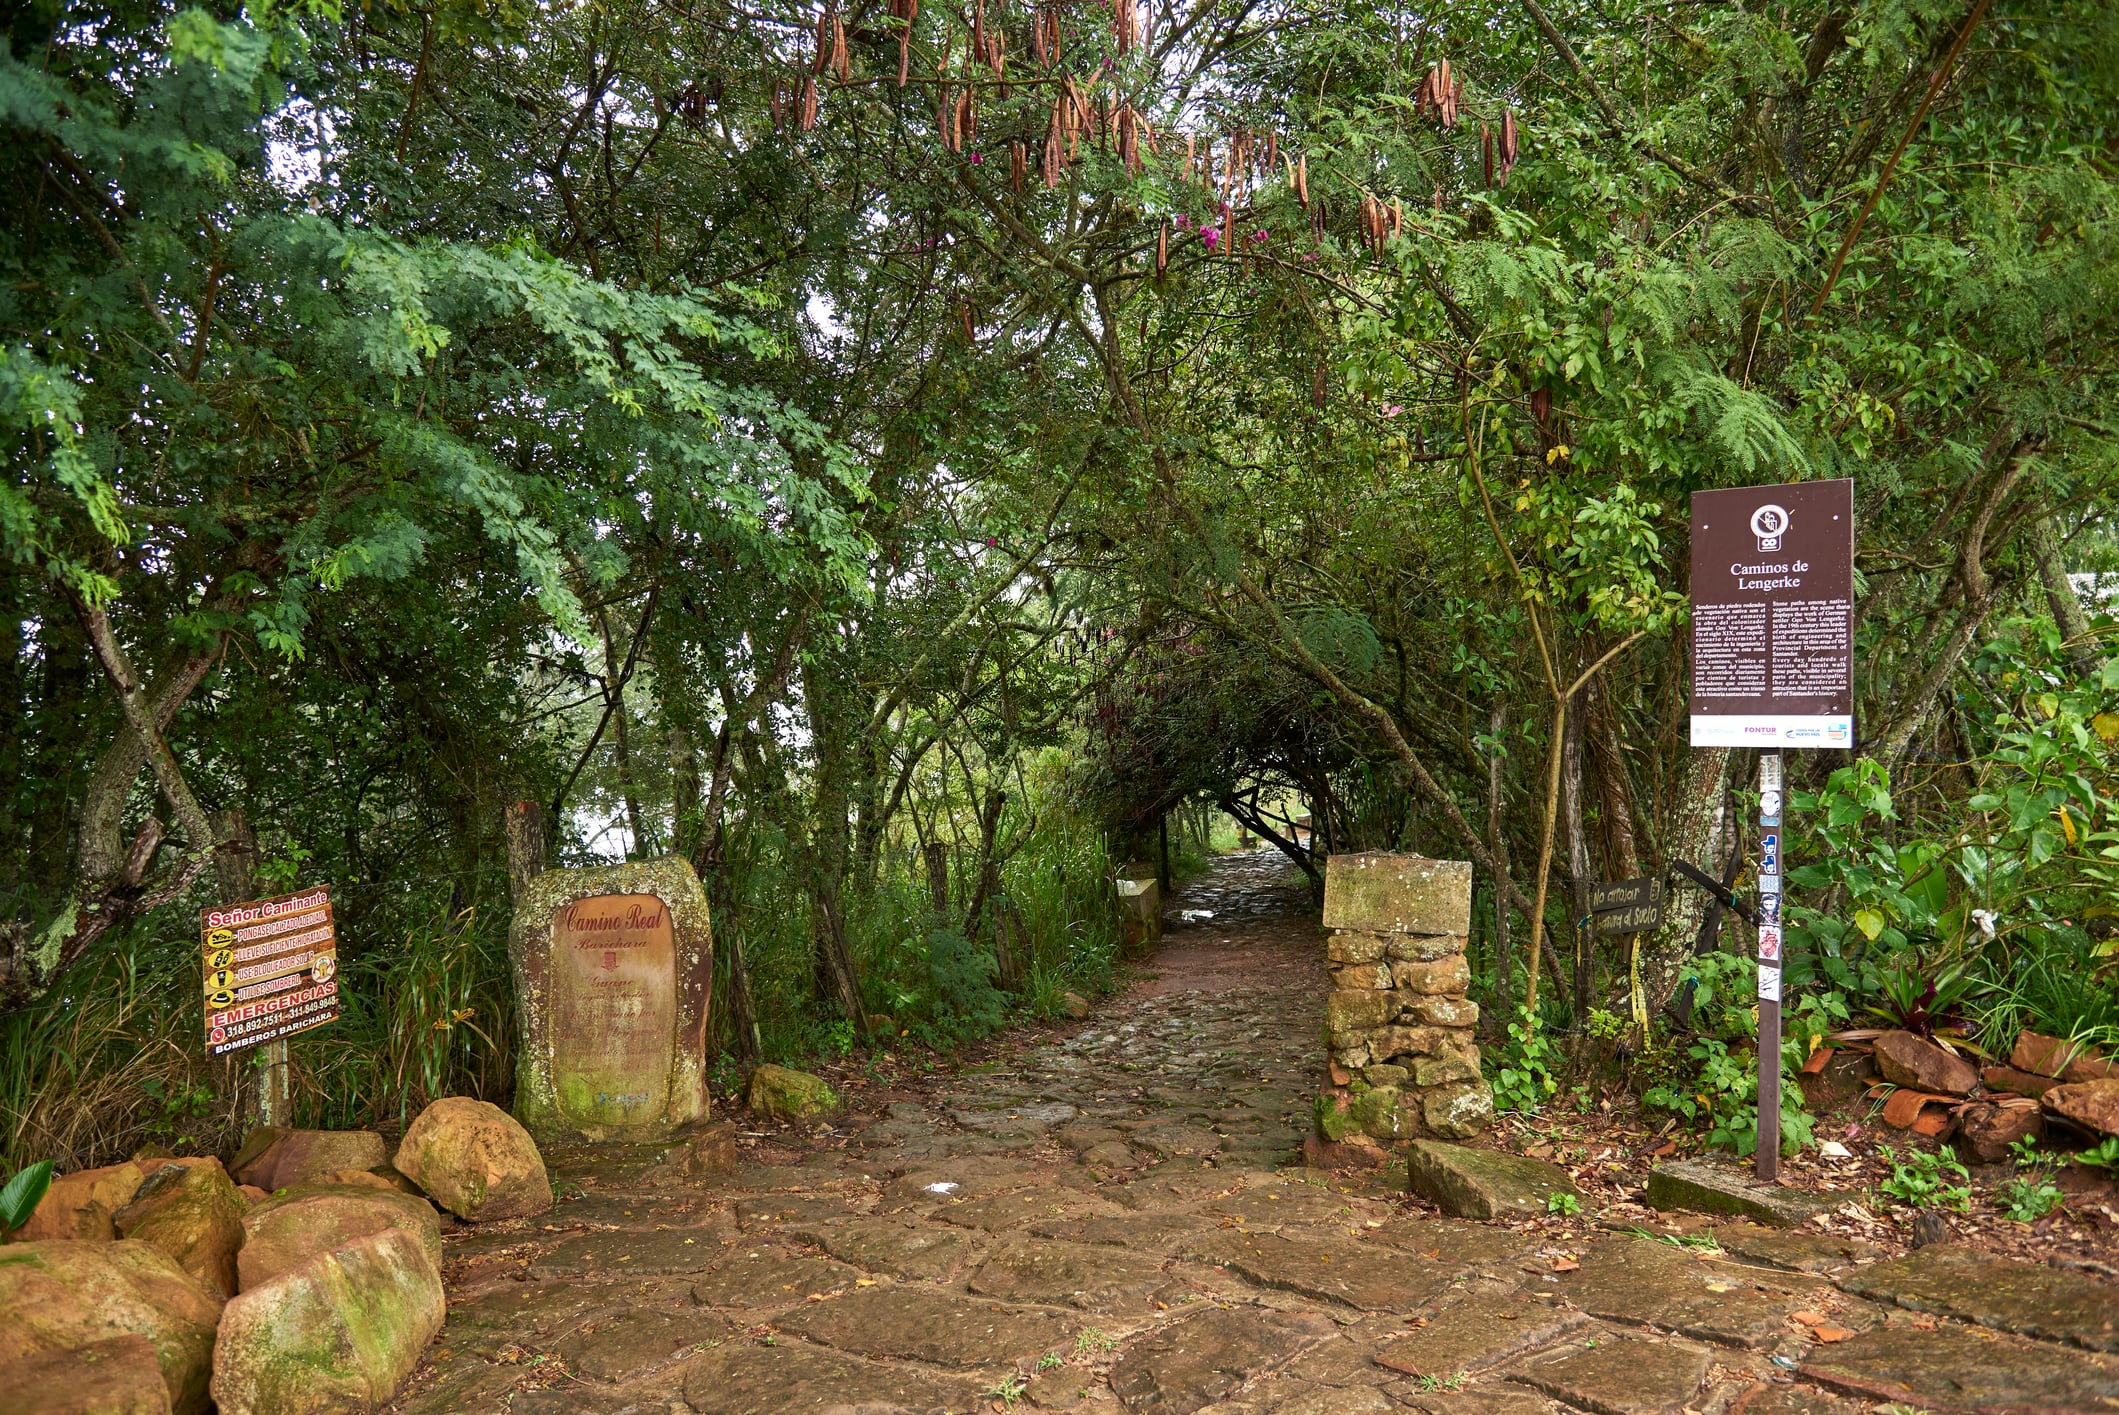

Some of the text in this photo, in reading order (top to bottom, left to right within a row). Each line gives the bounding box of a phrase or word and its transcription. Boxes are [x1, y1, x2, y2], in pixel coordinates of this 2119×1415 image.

[1731, 560, 1808, 575] Caminos de
[1738, 576, 1800, 591] Lengerke
[1594, 888, 1604, 906] No
[209, 891, 327, 927] Señor Caminante
[565, 904, 663, 932] Camino Real
[1624, 909, 1632, 927] al
[238, 925, 270, 941] PONGASE
[271, 917, 298, 934] CALZADO
[238, 946, 261, 961] LLEVE
[261, 938, 296, 957] SUFICIENTE
[574, 938, 648, 950] Barichara
[238, 968, 251, 980] USE
[254, 959, 295, 976] BLOQUEADOR
[296, 951, 314, 966] SOLAR
[213, 982, 335, 1027] EMERGENCIAS
[239, 986, 264, 1000] UTILICE
[227, 1024, 243, 1037] 318
[246, 1019, 261, 1032] 892
[264, 1013, 282, 1026] 7511
[289, 1006, 302, 1018] 311
[306, 1002, 318, 1014] 849
[216, 1012, 332, 1054] BOMBEROS BARICHARA
